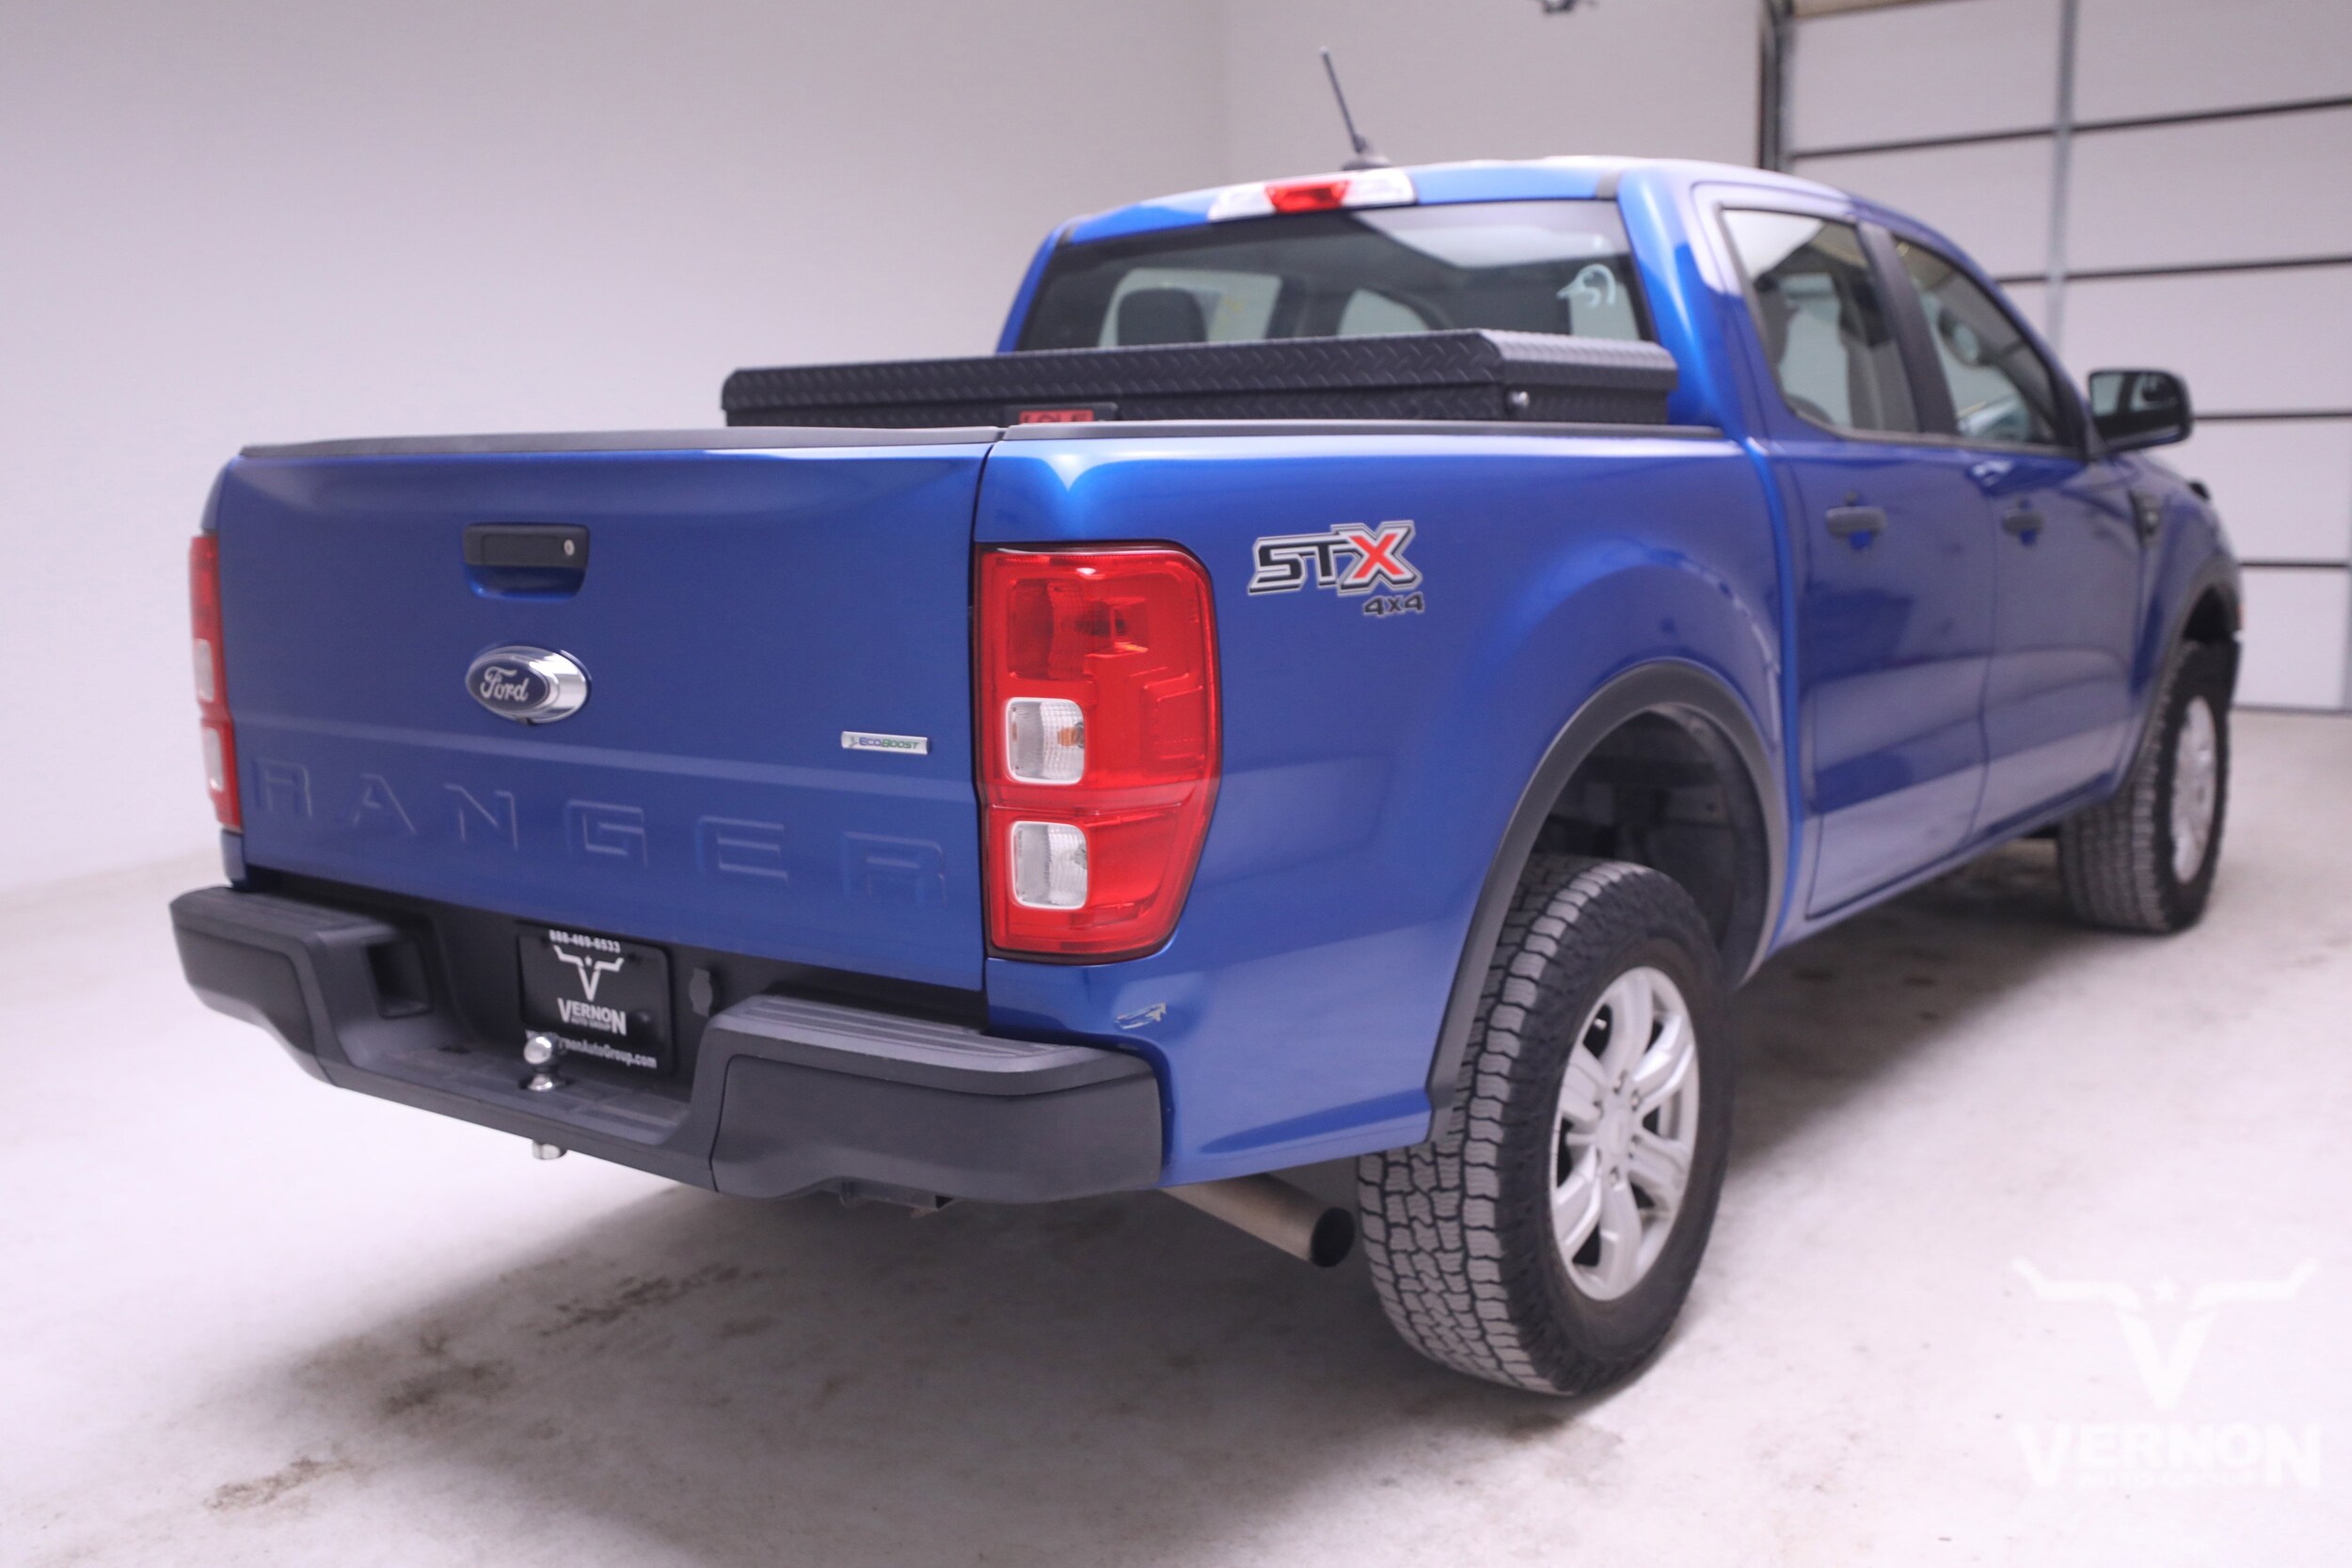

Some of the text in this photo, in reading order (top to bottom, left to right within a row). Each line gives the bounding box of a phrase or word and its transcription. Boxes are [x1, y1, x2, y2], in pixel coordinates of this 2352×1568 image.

[1248, 520, 1422, 595] STX
[479, 666, 531, 702] Ford
[858, 737, 919, 749] ECOBOOST
[253, 757, 946, 909] RANGER
[557, 997, 627, 1036] VERNON
